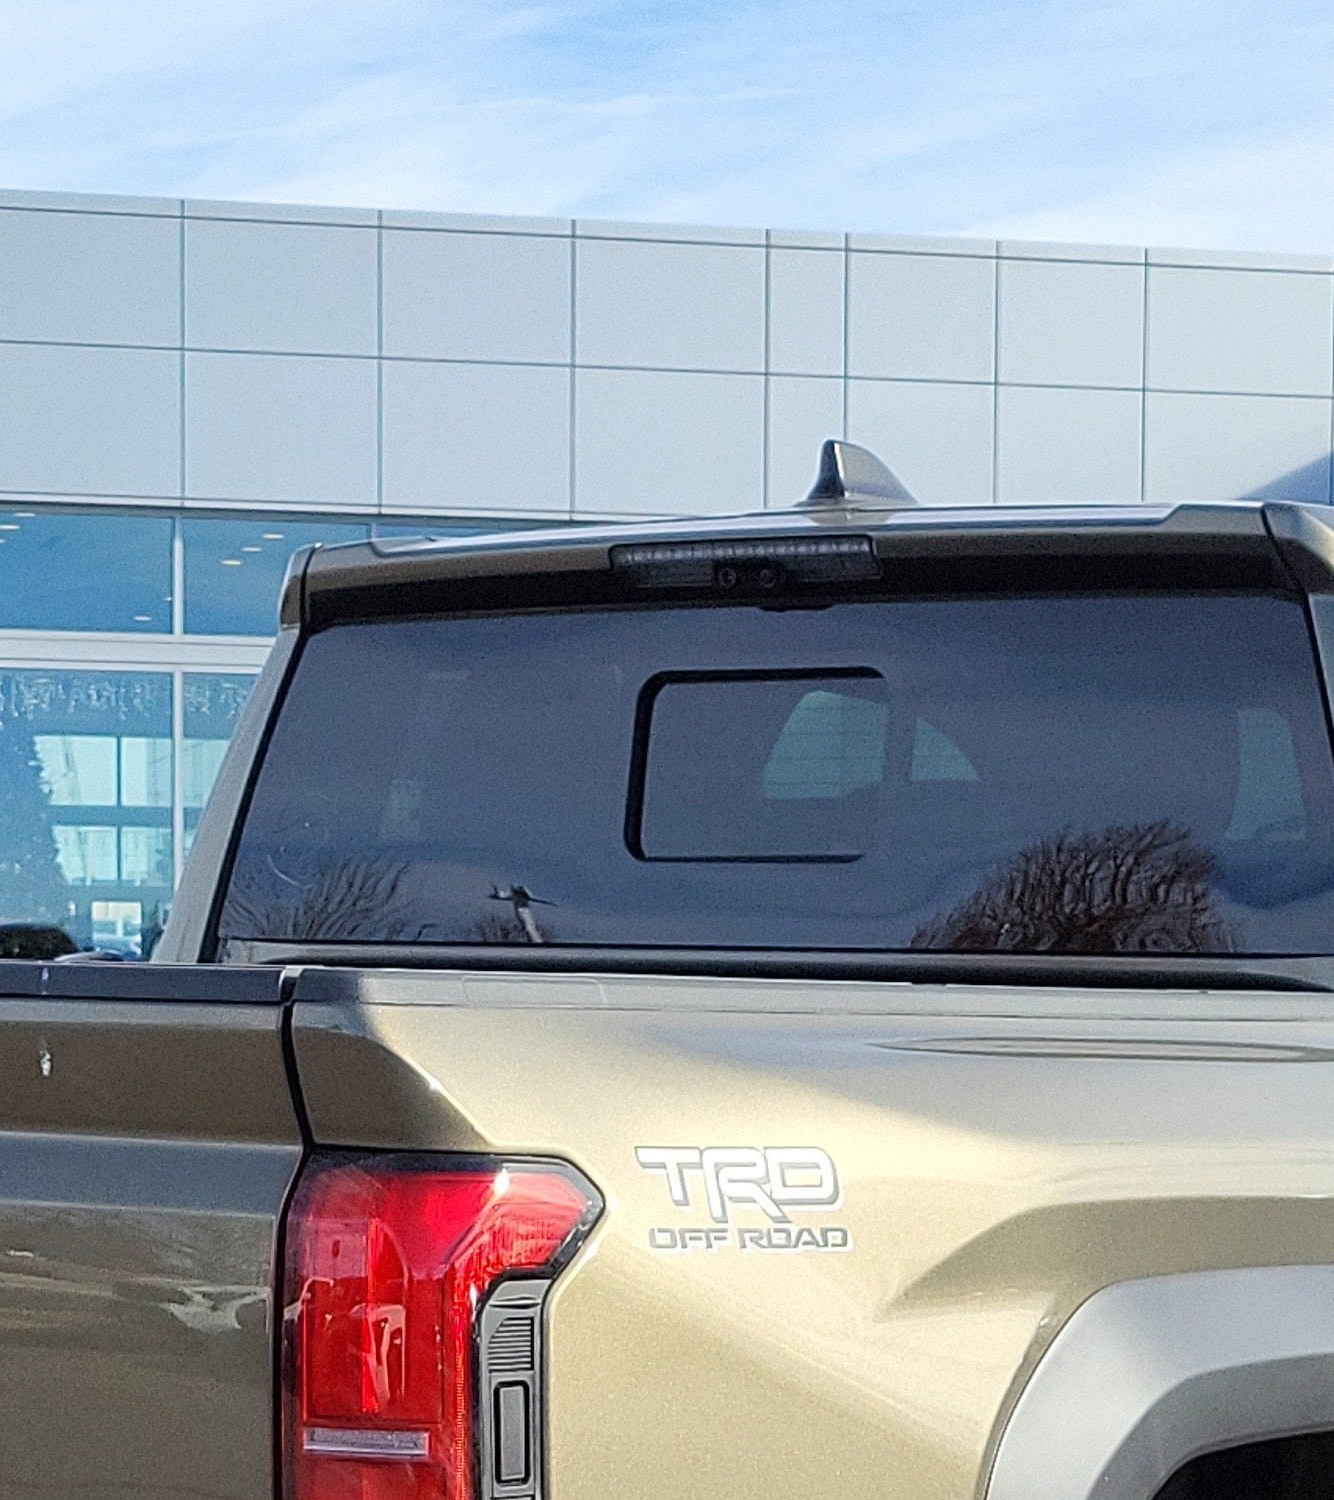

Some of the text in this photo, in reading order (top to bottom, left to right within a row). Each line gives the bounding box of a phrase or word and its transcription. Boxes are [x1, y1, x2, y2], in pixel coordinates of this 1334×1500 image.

[634, 1146, 841, 1223] TRD
[648, 1227, 849, 1250] OFF ROAD
